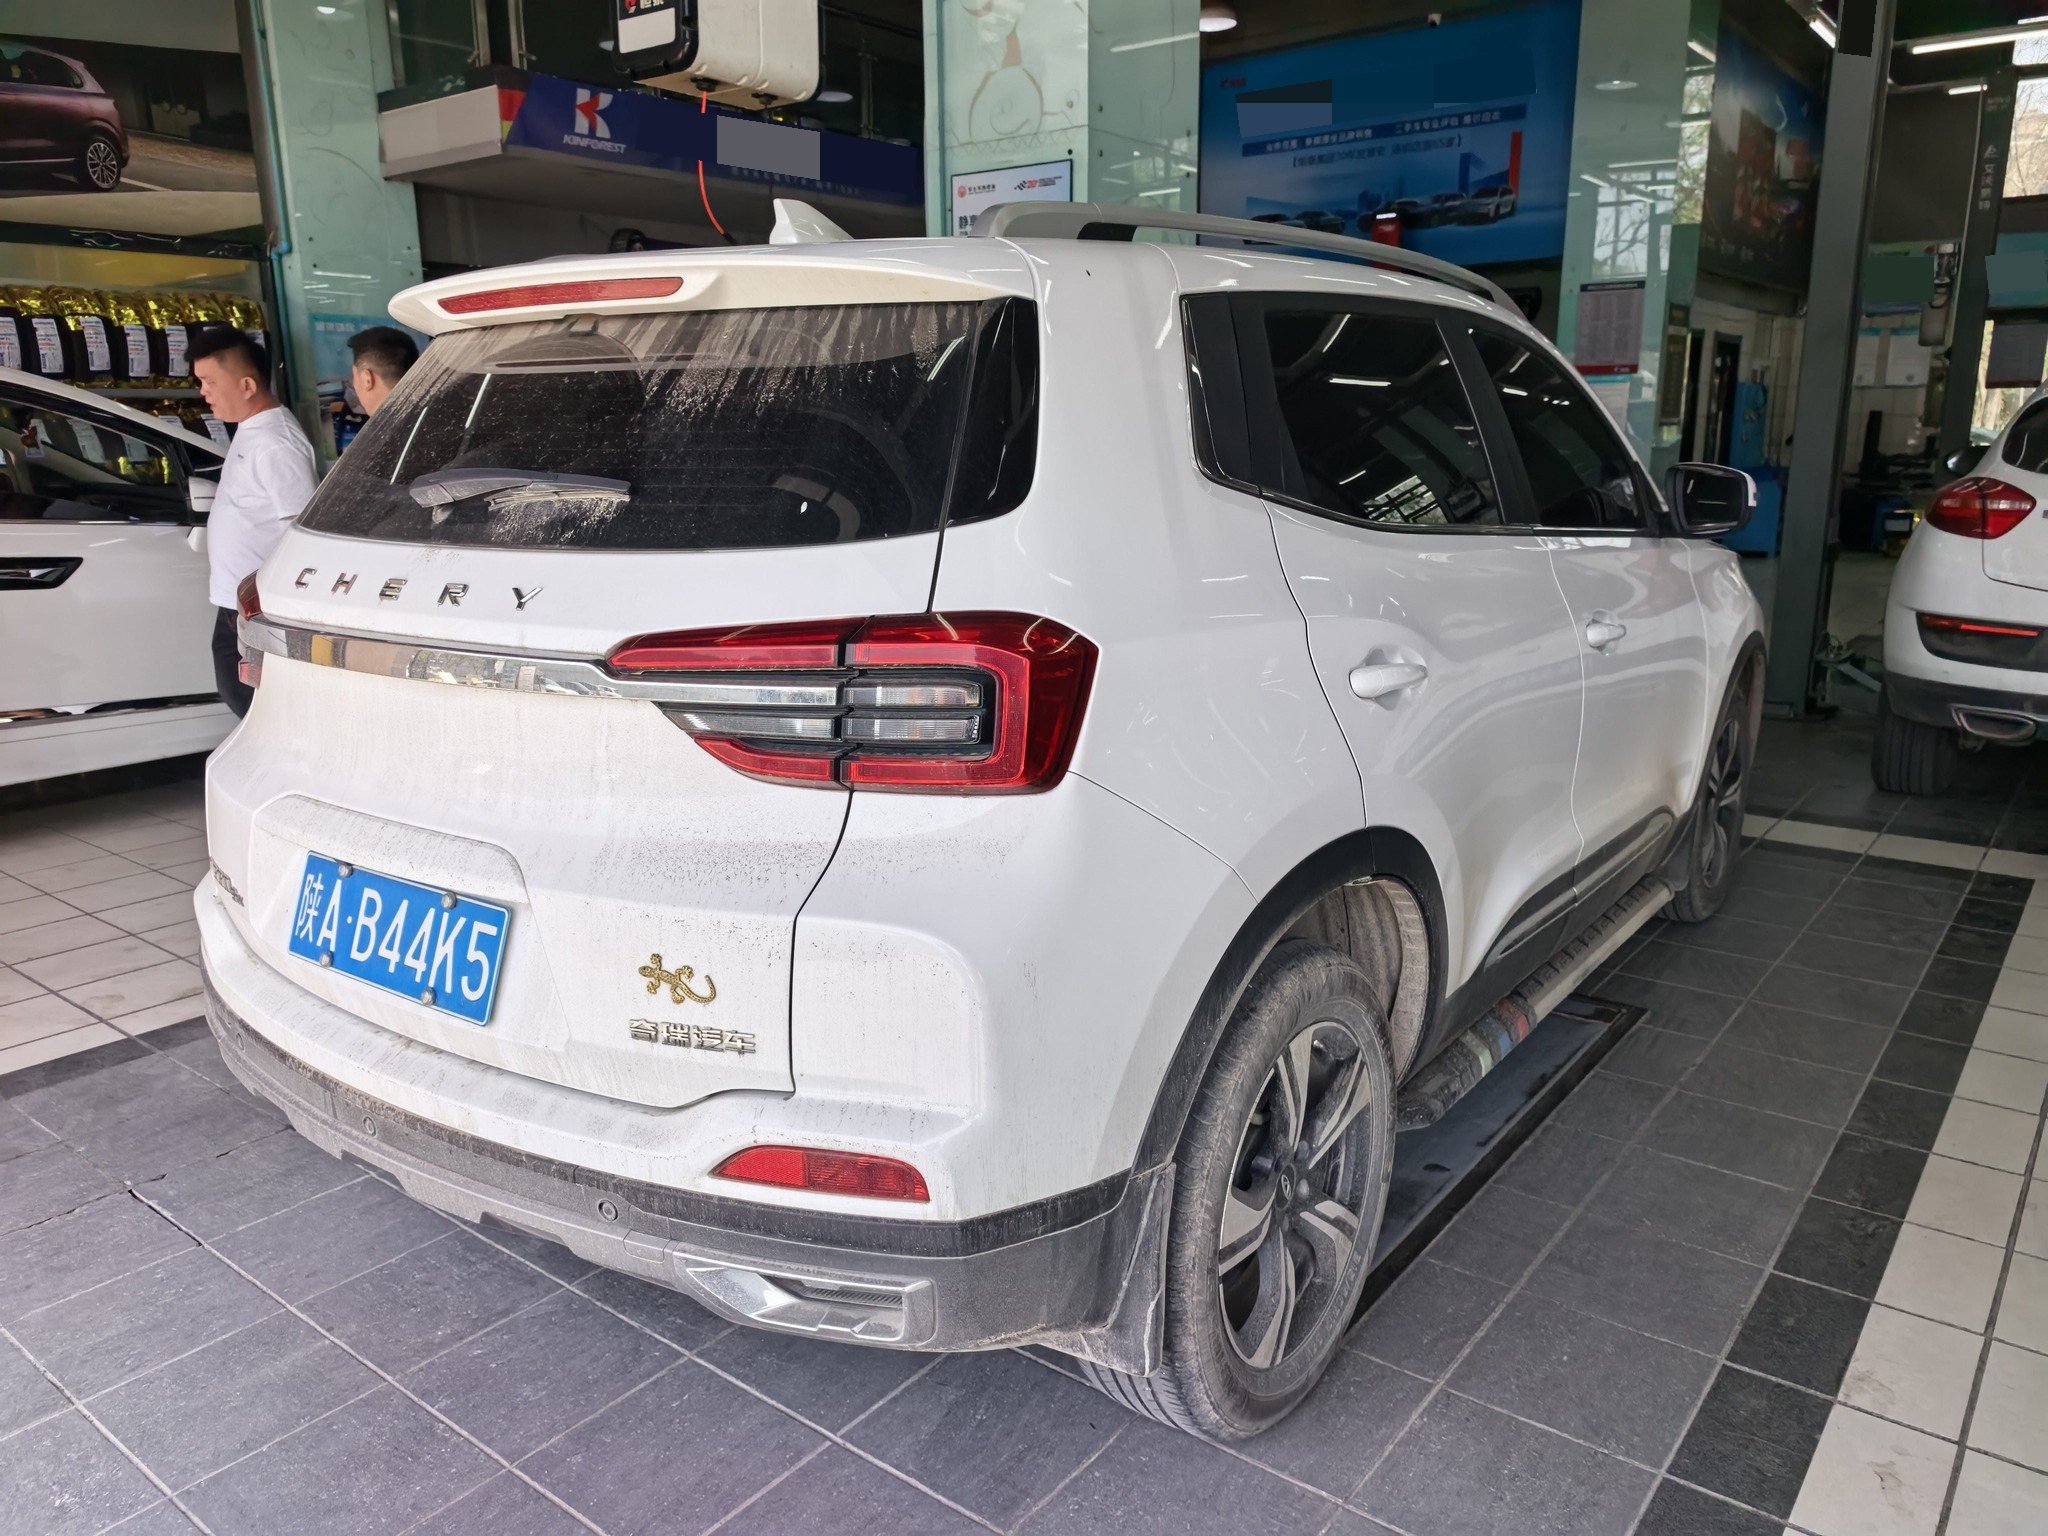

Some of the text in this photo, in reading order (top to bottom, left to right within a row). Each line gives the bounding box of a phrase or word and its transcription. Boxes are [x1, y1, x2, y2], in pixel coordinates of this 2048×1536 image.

[563, 134, 627, 154] KINFOREST
[294, 567, 543, 612] CHERY
[294, 872, 498, 1002] 陕A·B44K5
[629, 1018, 757, 1056] 奇瑞汽车
